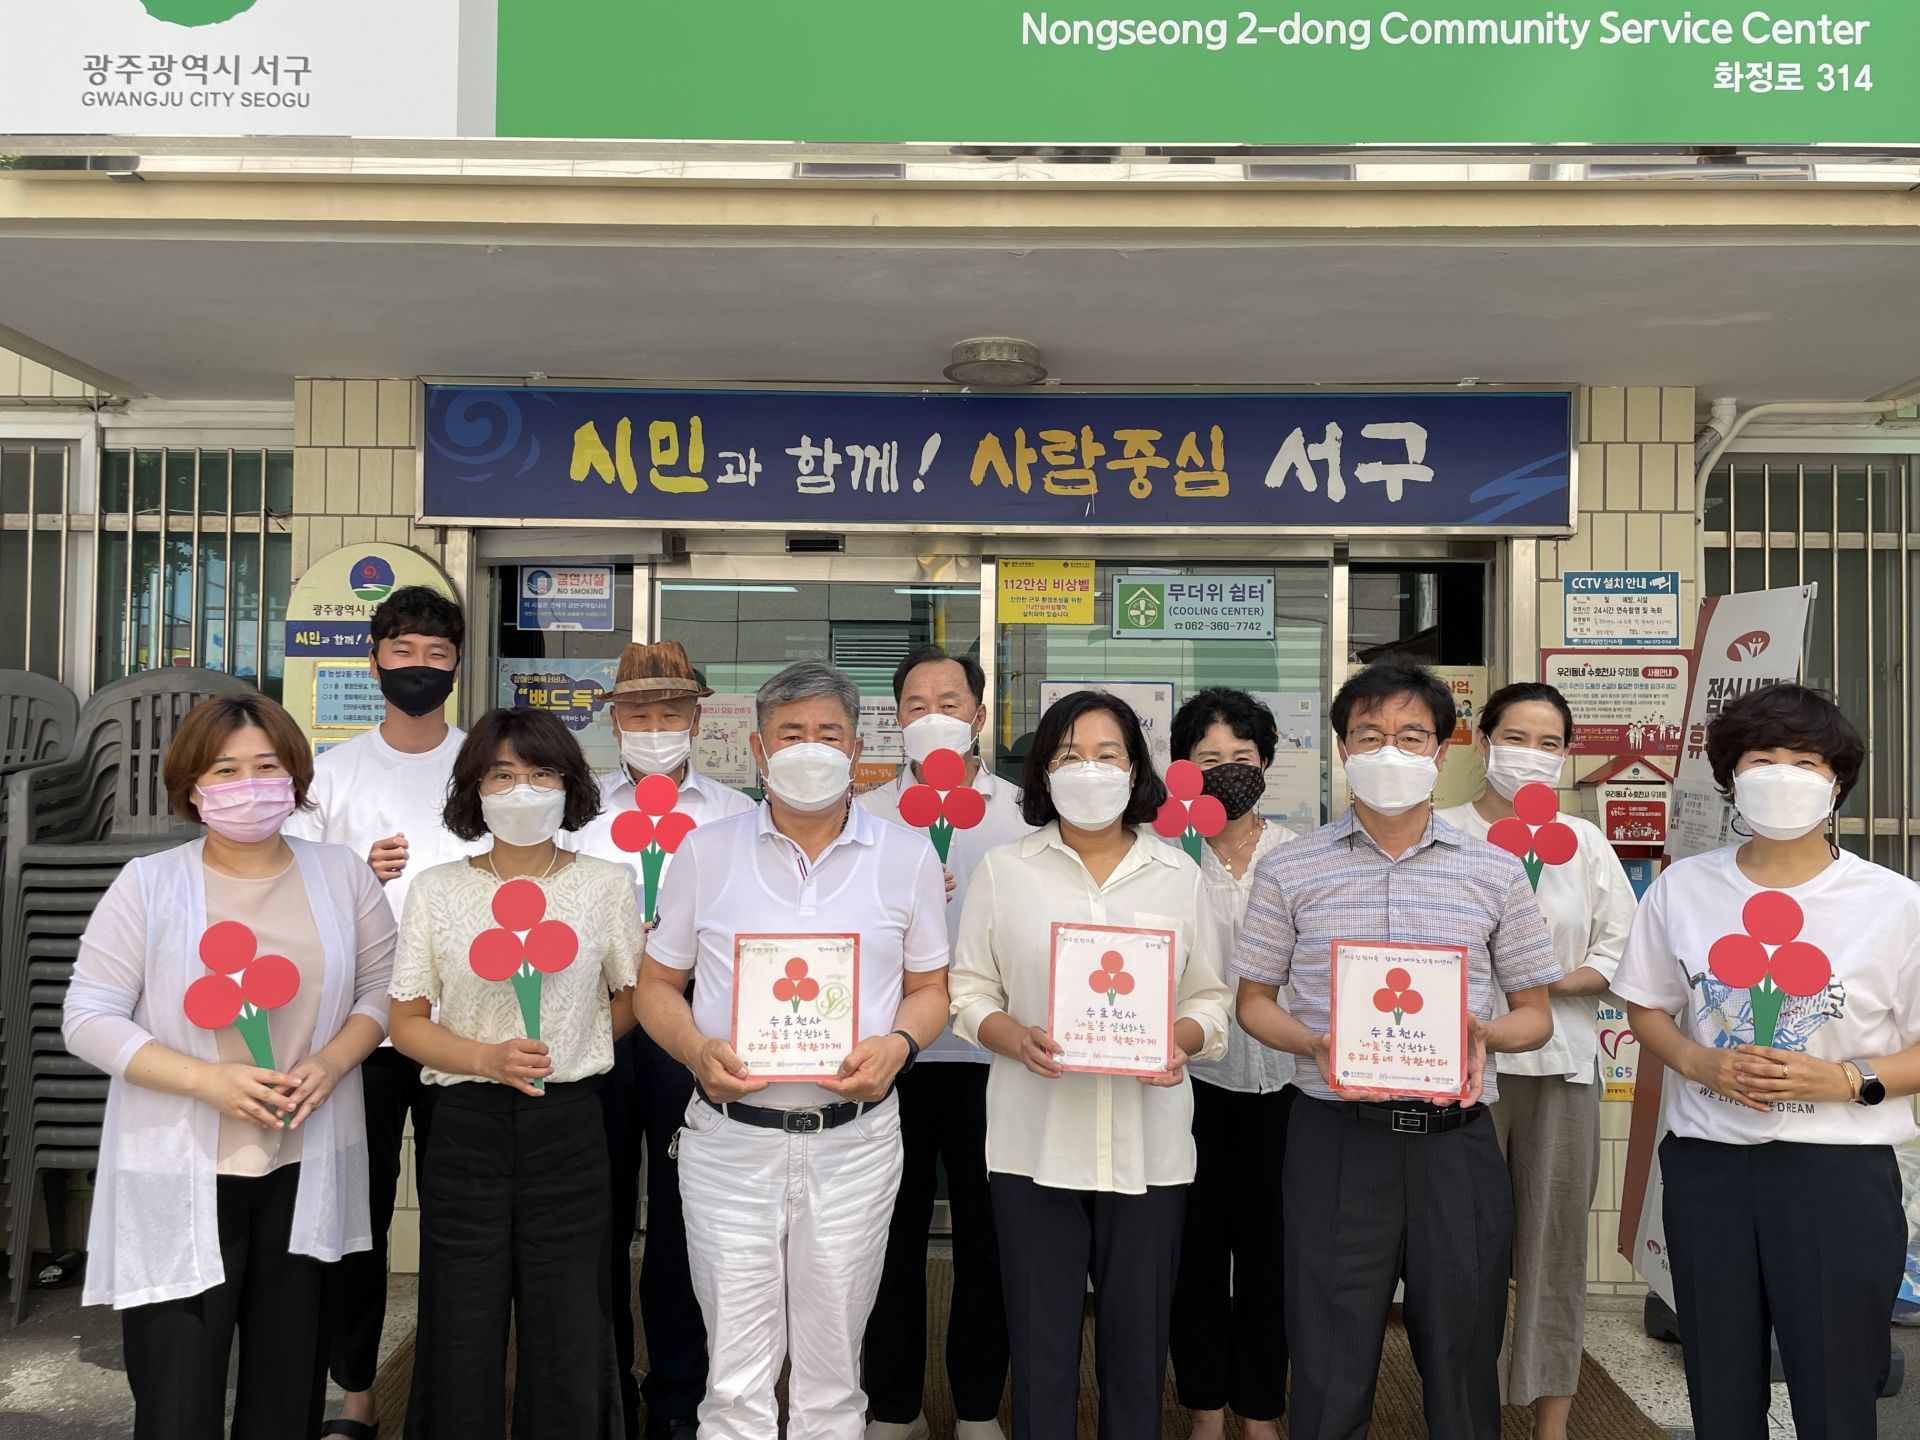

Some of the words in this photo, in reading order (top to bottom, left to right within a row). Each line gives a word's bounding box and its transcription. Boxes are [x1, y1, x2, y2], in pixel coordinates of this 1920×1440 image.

[1022, 12, 1227, 51] Nongseong
[1236, 12, 1370, 50] 2-dong
[1381, 12, 1591, 50] Community
[1600, 11, 1733, 45] Service
[1742, 11, 1870, 45] Center
[83, 54, 240, 86] 광주광역시
[251, 54, 312, 86] 서구
[1713, 61, 1804, 93] 화정로
[1817, 63, 1873, 92] 314
[82, 91, 183, 107] GWANGJU
[190, 91, 235, 107] CITY
[240, 91, 310, 108] SEOGU
[569, 415, 762, 494] 시민과
[785, 432, 941, 494] 함께!
[969, 424, 1229, 499] 사람중심
[1264, 421, 1435, 502] 서구
[557, 573, 605, 587] 금연시설
[1003, 578, 1047, 592] 112안심
[1053, 578, 1090, 592] 비상벨
[1571, 578, 1601, 589] CCTV
[1603, 577, 1624, 589] 설치
[1625, 577, 1647, 589] 안내
[1168, 583, 1223, 602] 무더위
[1229, 583, 1264, 602] 쉼터
[312, 604, 365, 616] 광주광역시
[1169, 606, 1218, 617] (COOLING
[1221, 606, 1264, 617] CENTER)
[1593, 606, 1614, 614] 24시간
[1185, 621, 1261, 631] 062-360-7742
[295, 631, 330, 645] 시민과
[328, 670, 352, 678] 농성2동
[1557, 667, 1586, 677] 우리동네
[1587, 667, 1616, 677] 수호천사
[1605, 790, 1627, 798] 우리동네
[1628, 790, 1649, 798] 수호천사
[1086, 1006, 1137, 1019] 수호천사
[769, 1015, 822, 1027] 수호천사
[1064, 1032, 1107, 1044] 우리동네
[1112, 1034, 1157, 1046] 착한가게
[1371, 1026, 1427, 1039] 수호천사
[747, 1042, 791, 1053] 우리동네
[797, 1042, 842, 1052] 착한가게
[1347, 1052, 1394, 1065] 우리동네
[1606, 1066, 1632, 1079] 365
[1700, 1086, 1714, 1099] WE
[1777, 1101, 1815, 1114] DREAM
